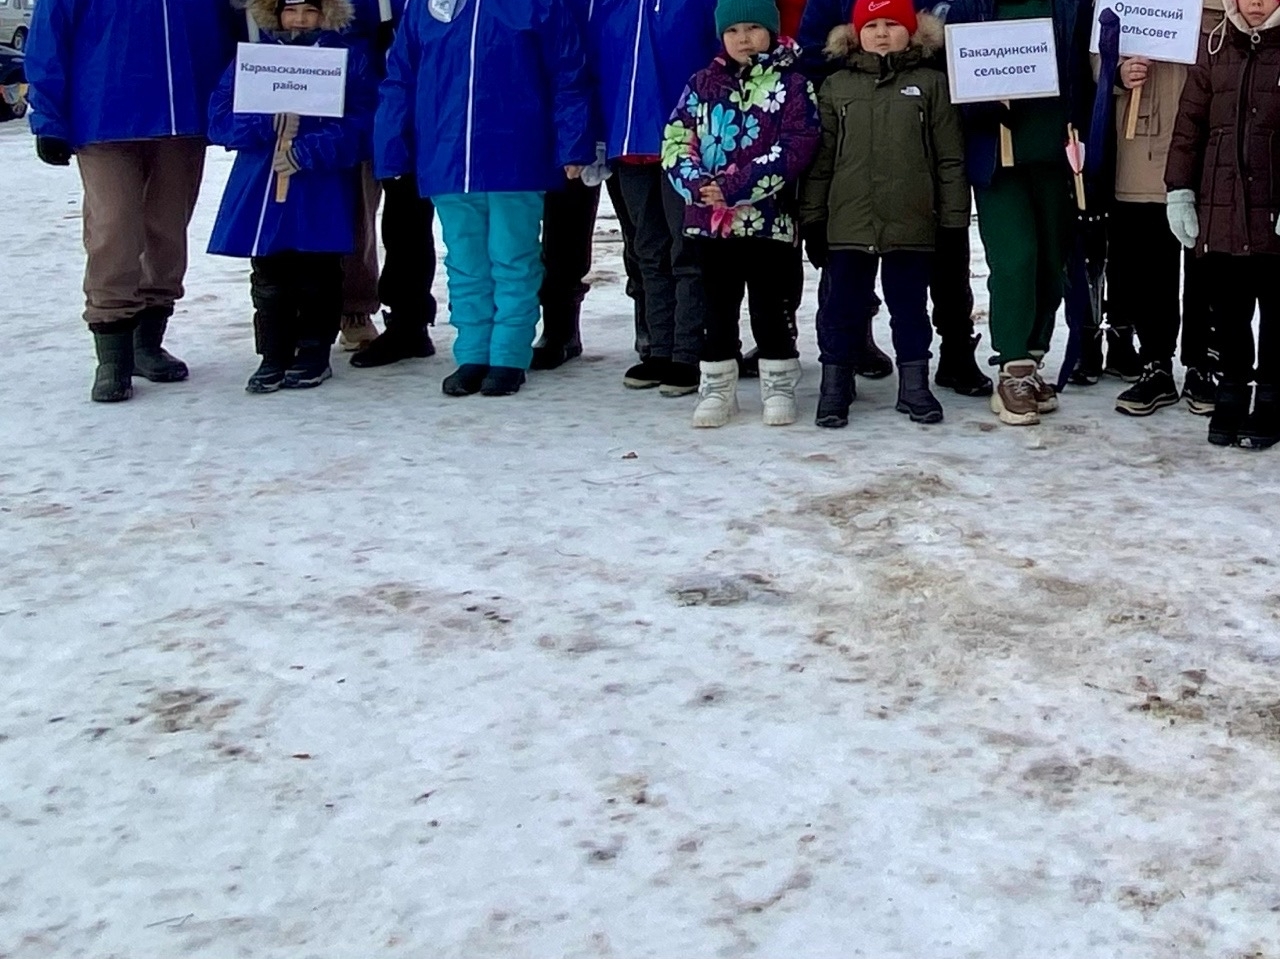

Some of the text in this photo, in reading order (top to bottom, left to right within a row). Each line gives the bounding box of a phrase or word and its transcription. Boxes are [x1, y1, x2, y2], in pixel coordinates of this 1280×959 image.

[1115, 2, 1183, 20] Орловский
[1120, 25, 1178, 39] ельсовет
[959, 42, 1048, 59] Бакалдинский
[240, 62, 342, 77] Кармаскалинский
[973, 63, 1037, 77] сельсовет
[273, 81, 308, 91] район
